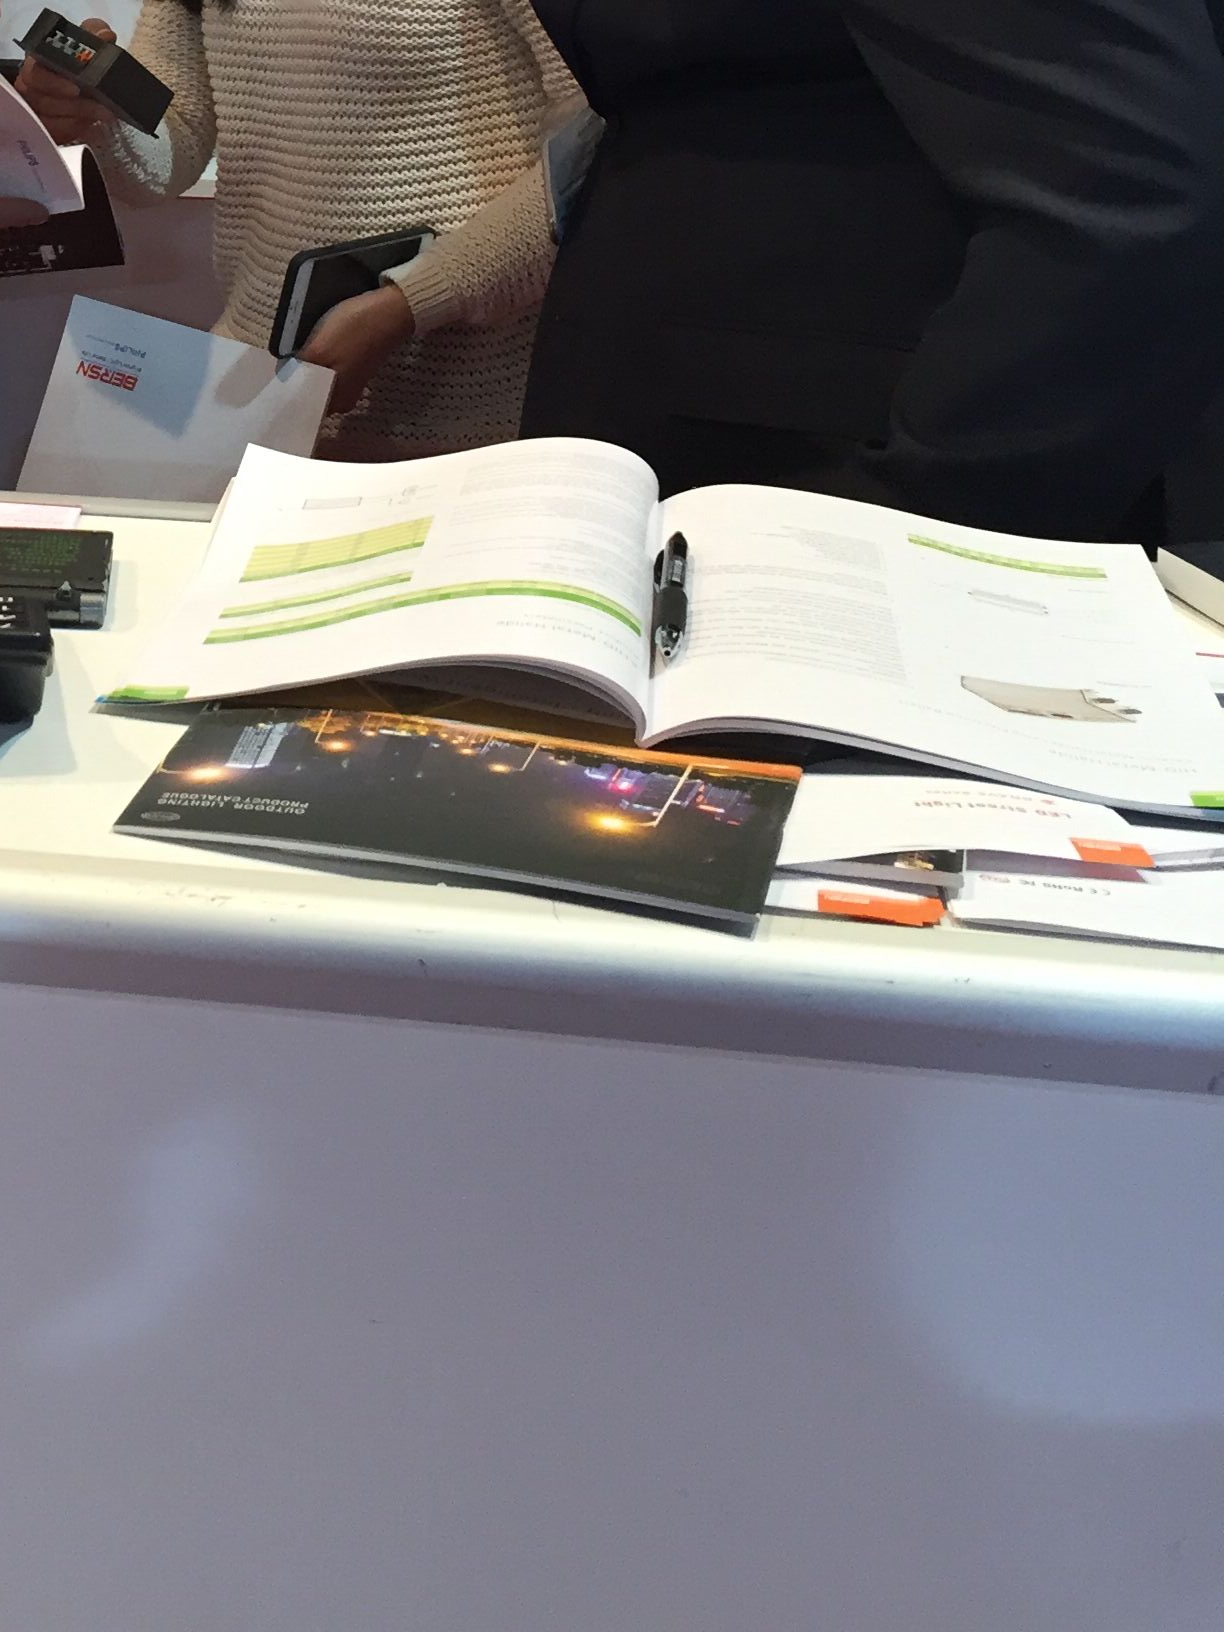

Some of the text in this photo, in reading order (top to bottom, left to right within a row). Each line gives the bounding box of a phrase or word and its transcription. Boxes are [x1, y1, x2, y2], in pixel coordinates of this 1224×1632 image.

[76, 361, 138, 391] BERSN
[157, 798, 306, 816] OUTDOOR LIGHTING
[160, 791, 310, 809] PRODUCT CATALOGUE
[913, 799, 964, 810] Light
[966, 802, 1028, 814] Street
